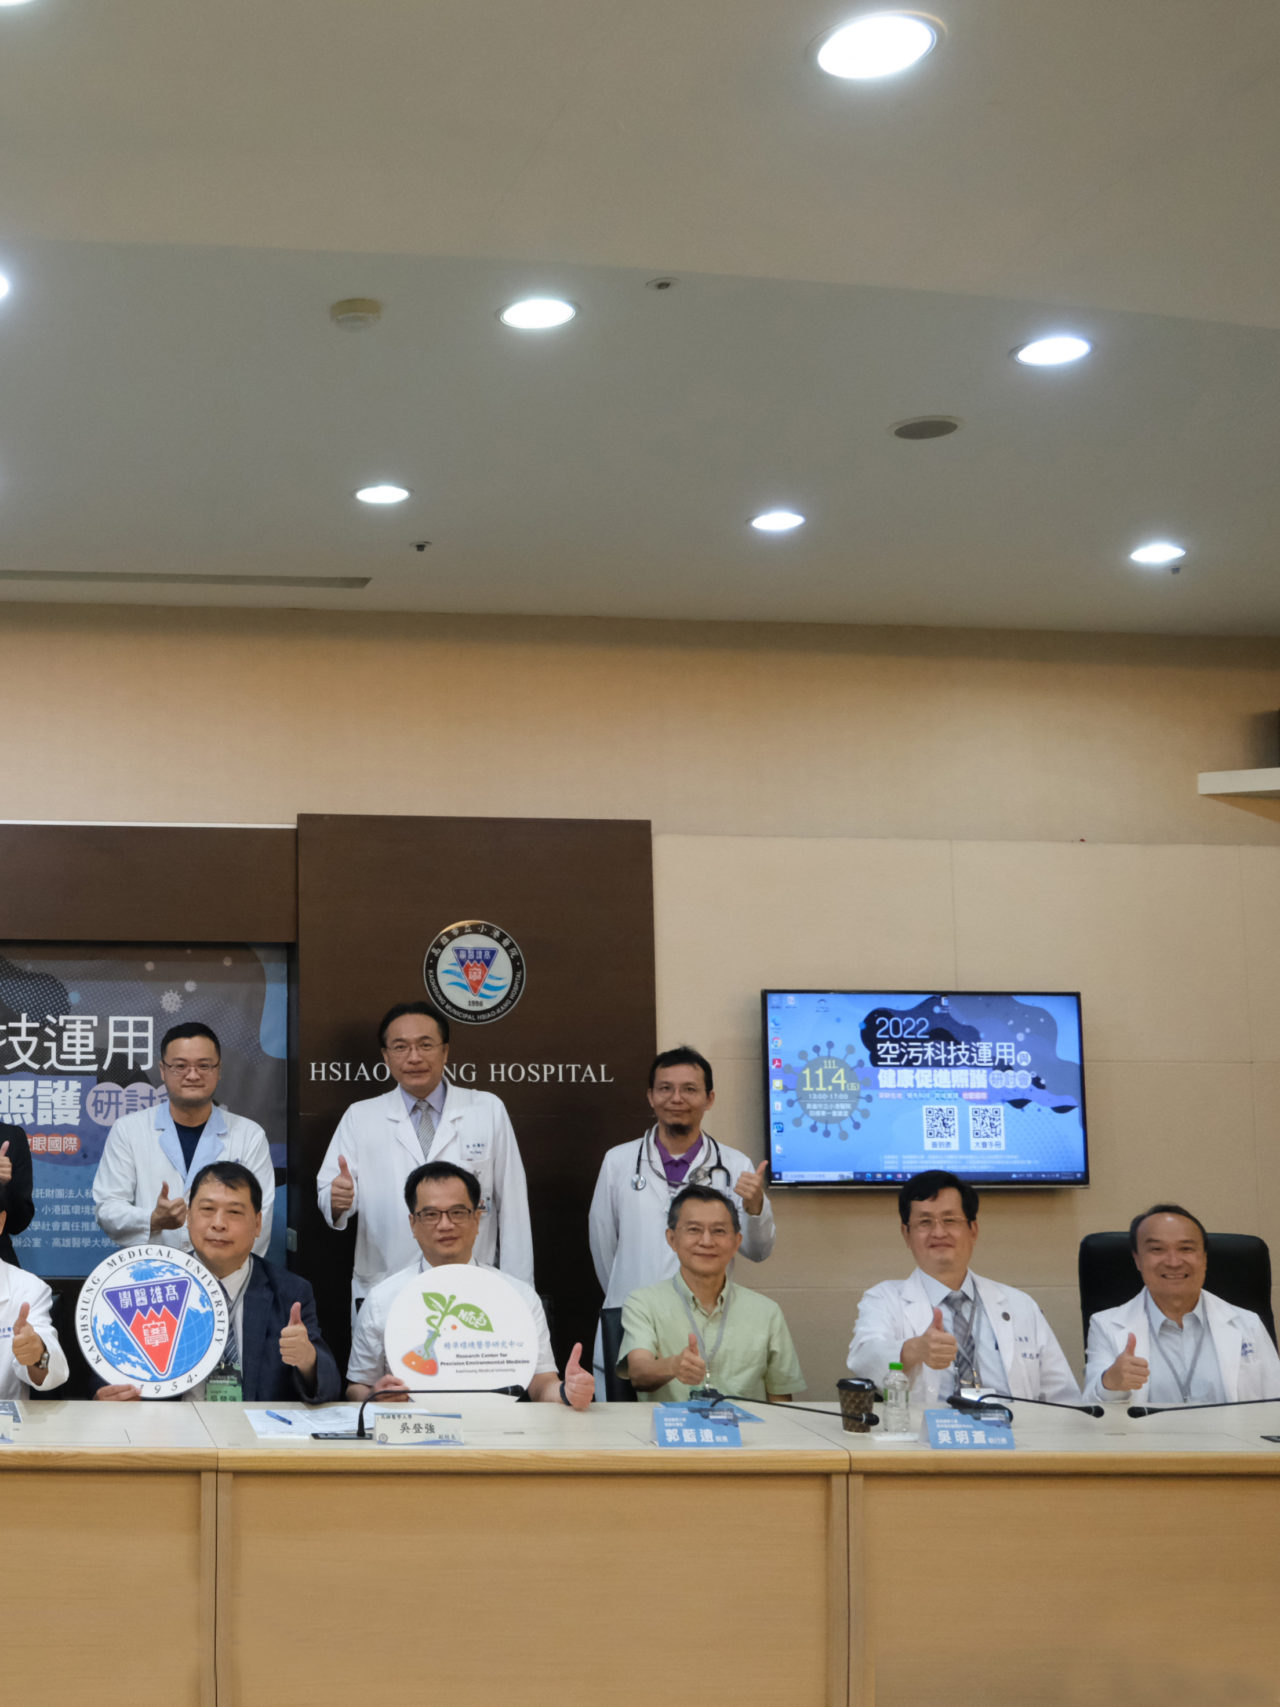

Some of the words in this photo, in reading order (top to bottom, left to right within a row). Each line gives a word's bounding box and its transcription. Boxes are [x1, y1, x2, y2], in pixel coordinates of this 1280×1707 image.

[875, 1017, 930, 1039] 2022
[489, 1063, 614, 1083] HOSPITAL
[79, 1276, 102, 1366] KAOHSIUNG
[107, 1247, 174, 1269] MEDICAL
[185, 1259, 226, 1346] UNIVERSITY
[400, 1422, 436, 1434] 吳登強
